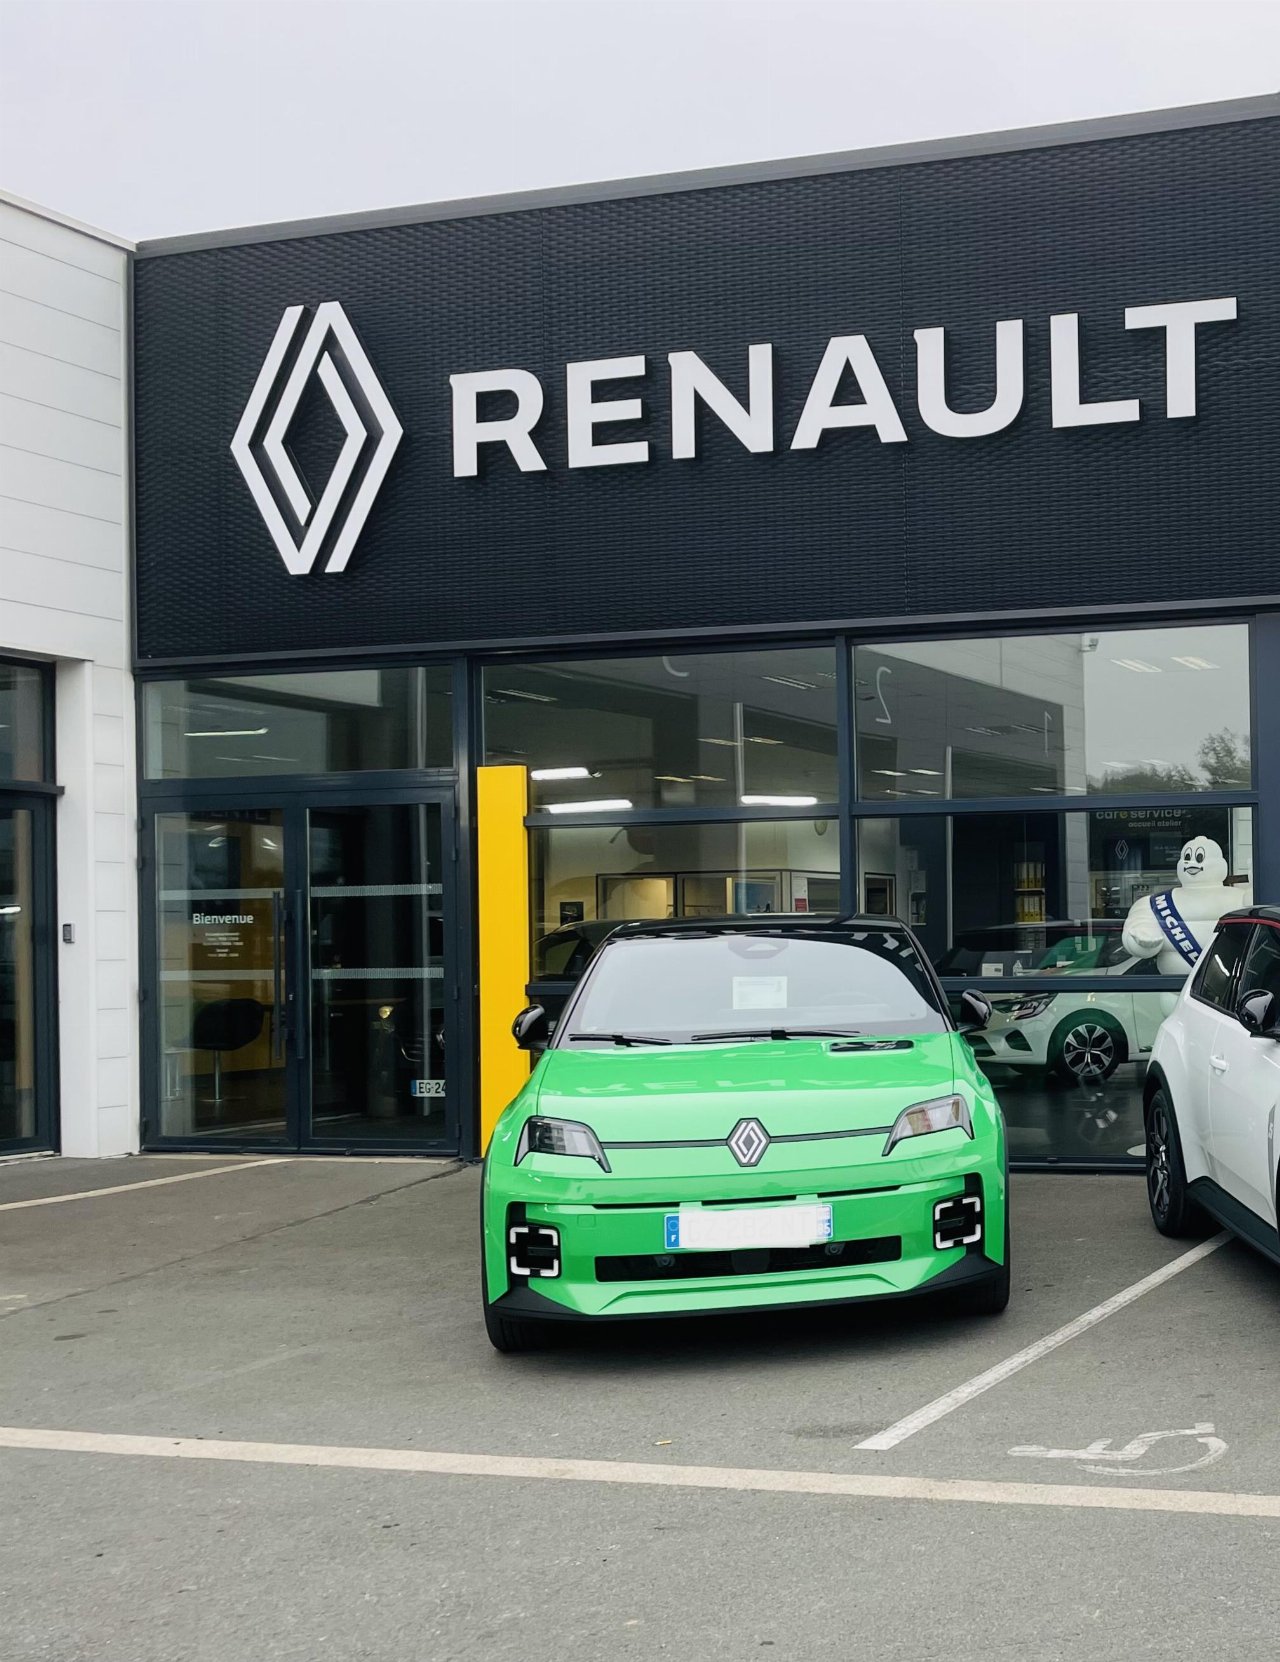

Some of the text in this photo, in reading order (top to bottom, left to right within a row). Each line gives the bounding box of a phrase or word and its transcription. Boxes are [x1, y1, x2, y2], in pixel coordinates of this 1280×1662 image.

[449, 297, 1237, 478] RENAULT
[192, 912, 255, 925] Bienvenue
[1155, 894, 1200, 963] MICHEL
[418, 1080, 447, 1094] EG-24
